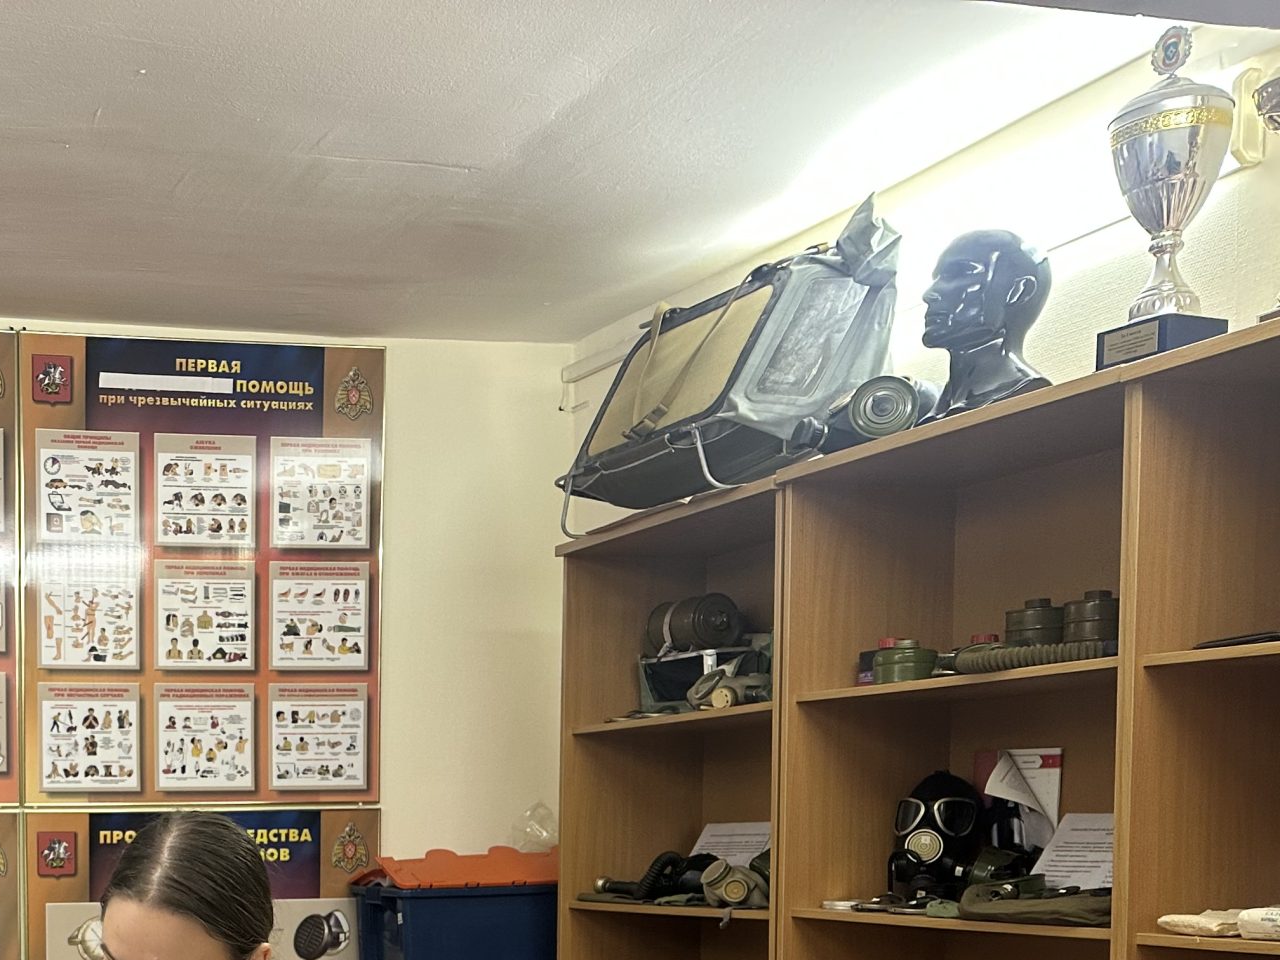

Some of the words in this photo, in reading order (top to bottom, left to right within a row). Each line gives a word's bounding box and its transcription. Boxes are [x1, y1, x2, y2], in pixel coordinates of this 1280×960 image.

[175, 358, 241, 373] ПЕРВАЯ
[236, 378, 314, 396] ПОМОЩЬ
[99, 395, 126, 406] при
[128, 392, 236, 409] чрезвычайных
[240, 398, 314, 412] ситуациях
